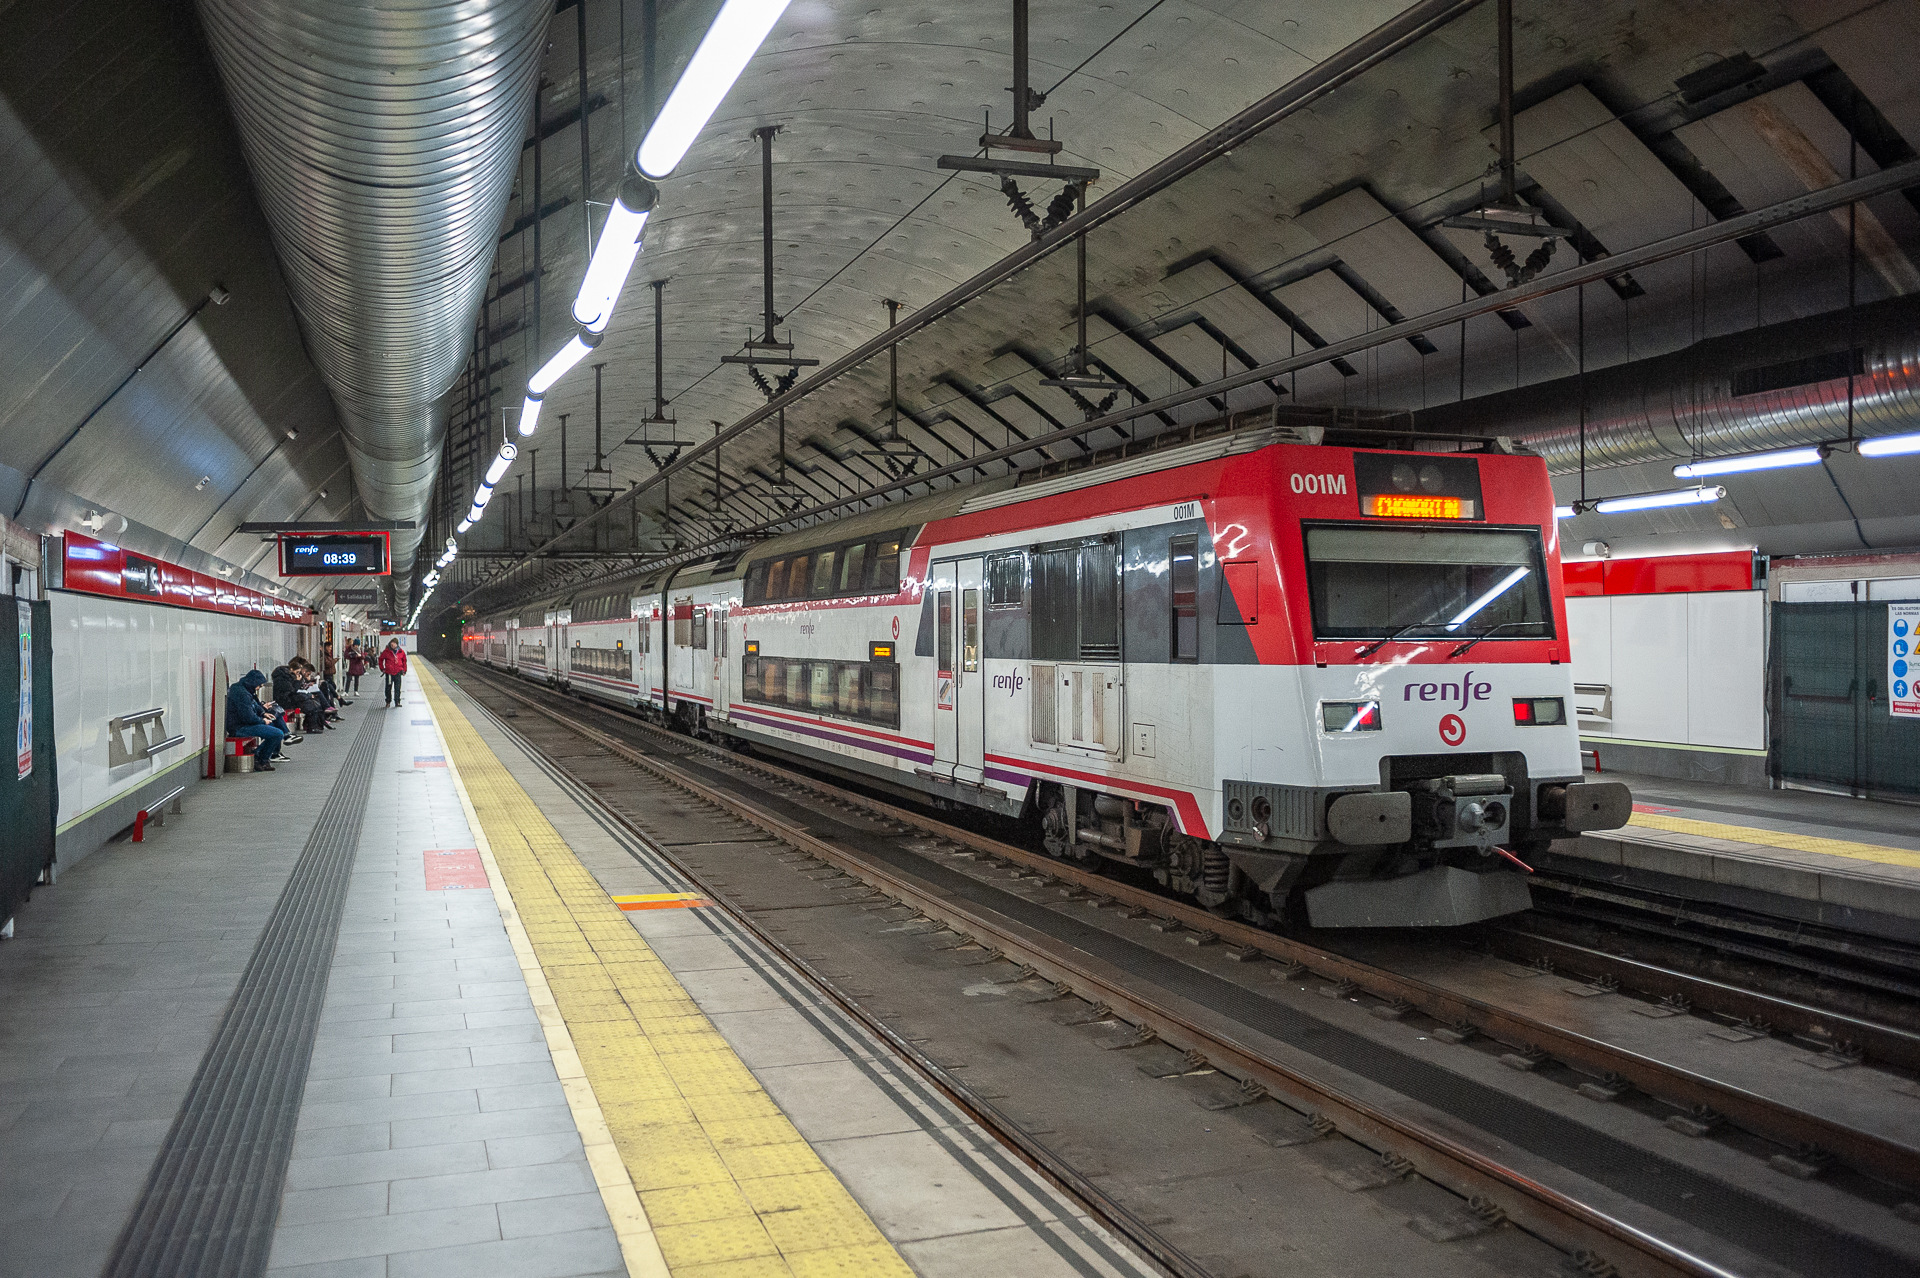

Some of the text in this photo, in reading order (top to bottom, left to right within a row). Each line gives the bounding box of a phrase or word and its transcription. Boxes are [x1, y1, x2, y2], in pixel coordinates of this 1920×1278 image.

[1290, 473, 1347, 495] 001M
[1173, 503, 1195, 520] 001M
[294, 545, 319, 555] renfe
[323, 553, 357, 564] 08:39
[800, 618, 815, 640] renfe
[993, 667, 1024, 698] renfe
[1403, 670, 1492, 712] renfe
